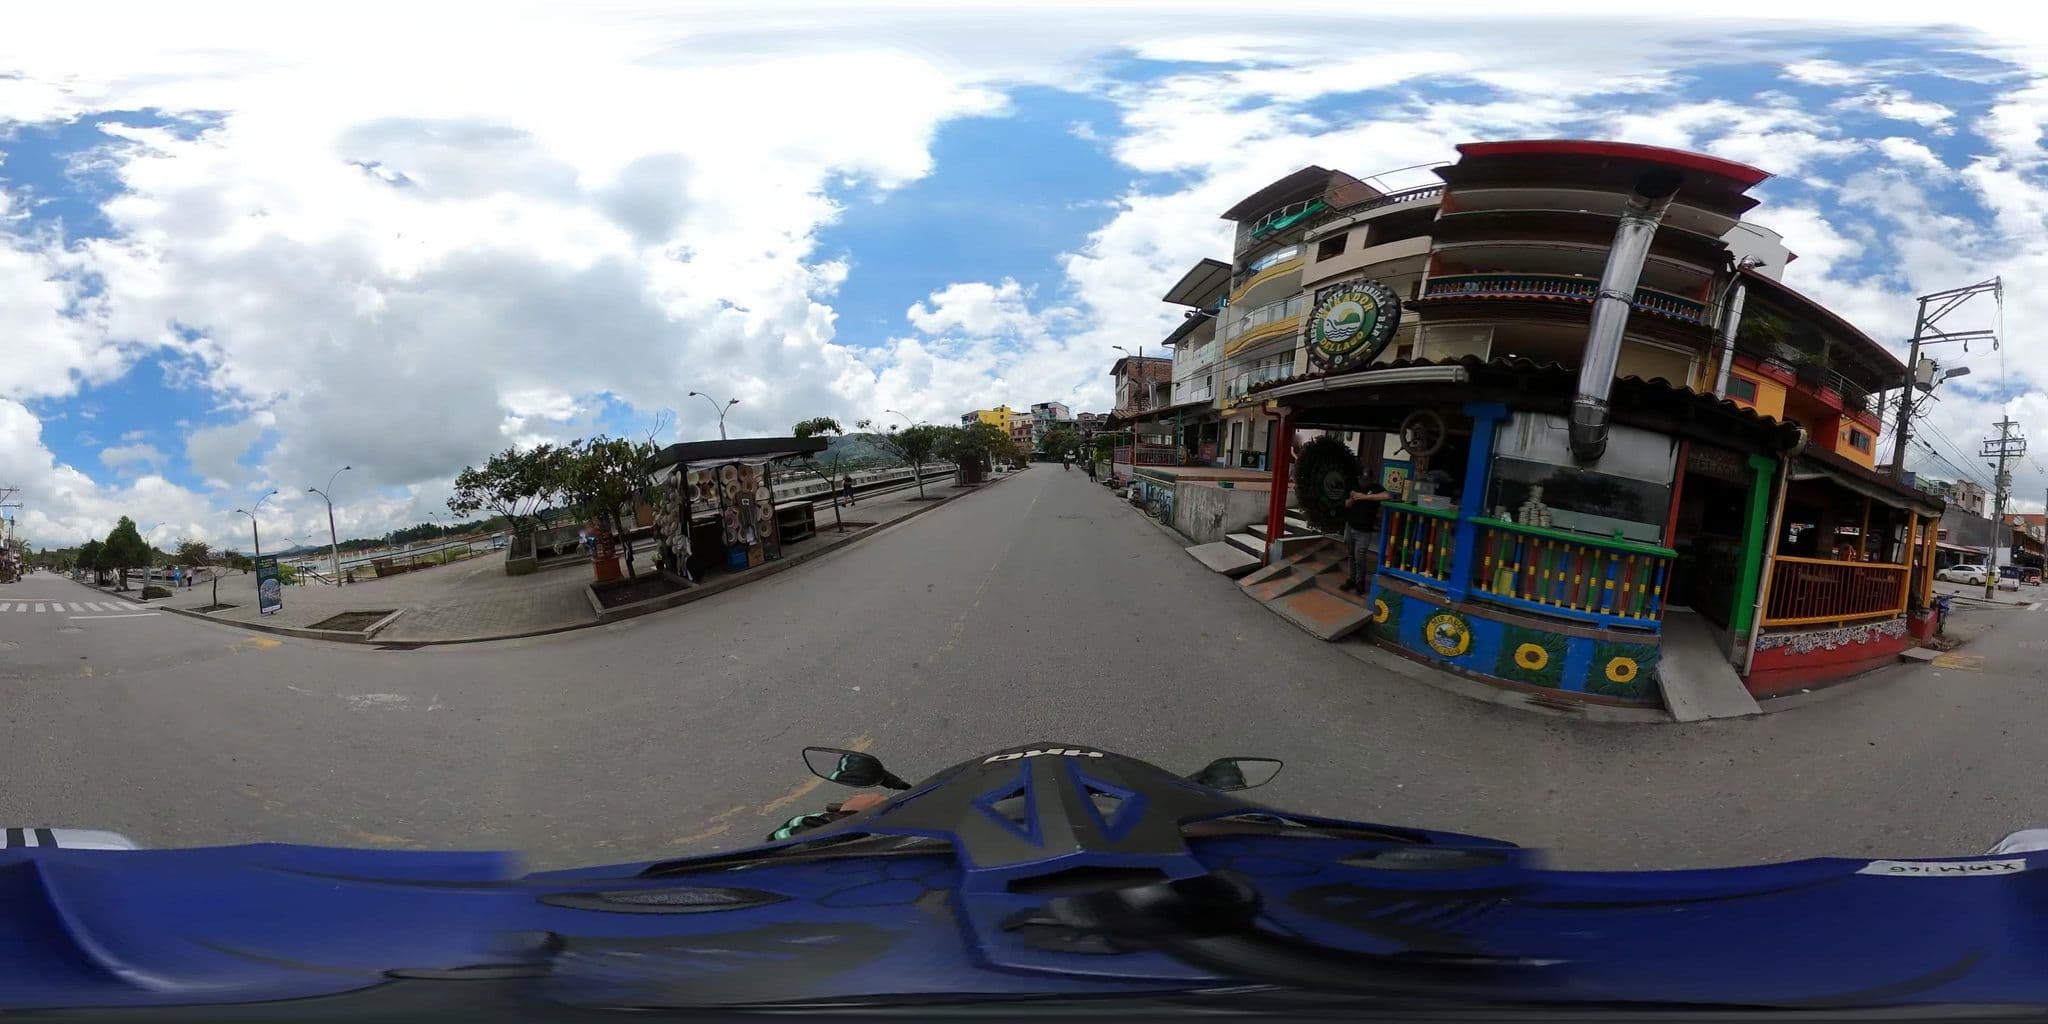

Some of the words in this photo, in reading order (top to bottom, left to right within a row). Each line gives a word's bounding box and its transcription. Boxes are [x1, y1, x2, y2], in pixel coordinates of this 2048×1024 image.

[1320, 292, 1374, 319] MIRADOR
[1352, 285, 1386, 308] PARRILLA
[1371, 316, 1386, 337] BAR
